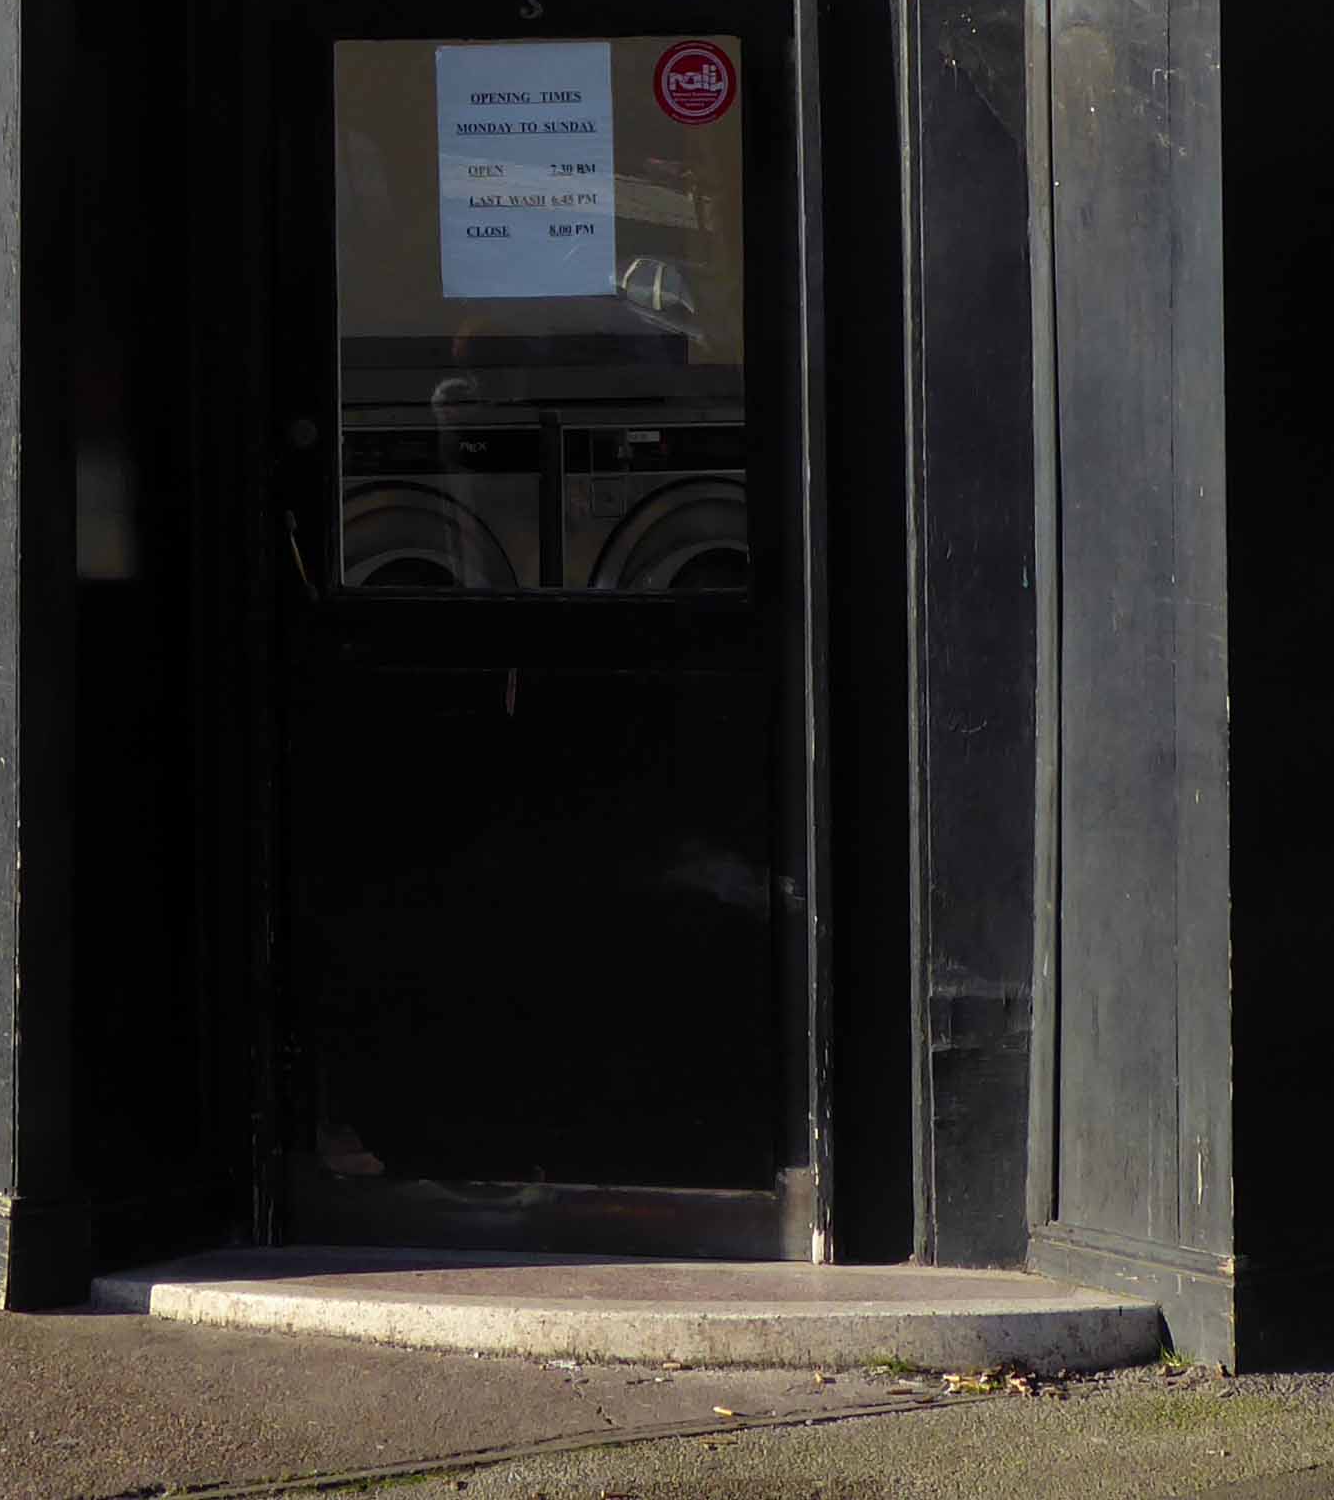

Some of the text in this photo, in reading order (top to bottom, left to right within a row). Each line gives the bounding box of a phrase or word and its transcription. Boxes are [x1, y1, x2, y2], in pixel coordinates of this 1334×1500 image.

[470, 91, 582, 104] OPENING TIMES
[457, 120, 597, 135] MONDAY TO SUNDAY
[467, 164, 505, 177] OPEN
[469, 195, 503, 207] LAST
[509, 195, 547, 206] WASH
[577, 193, 597, 205] PM
[466, 225, 510, 238] CLOSE
[576, 223, 595, 235] PM
